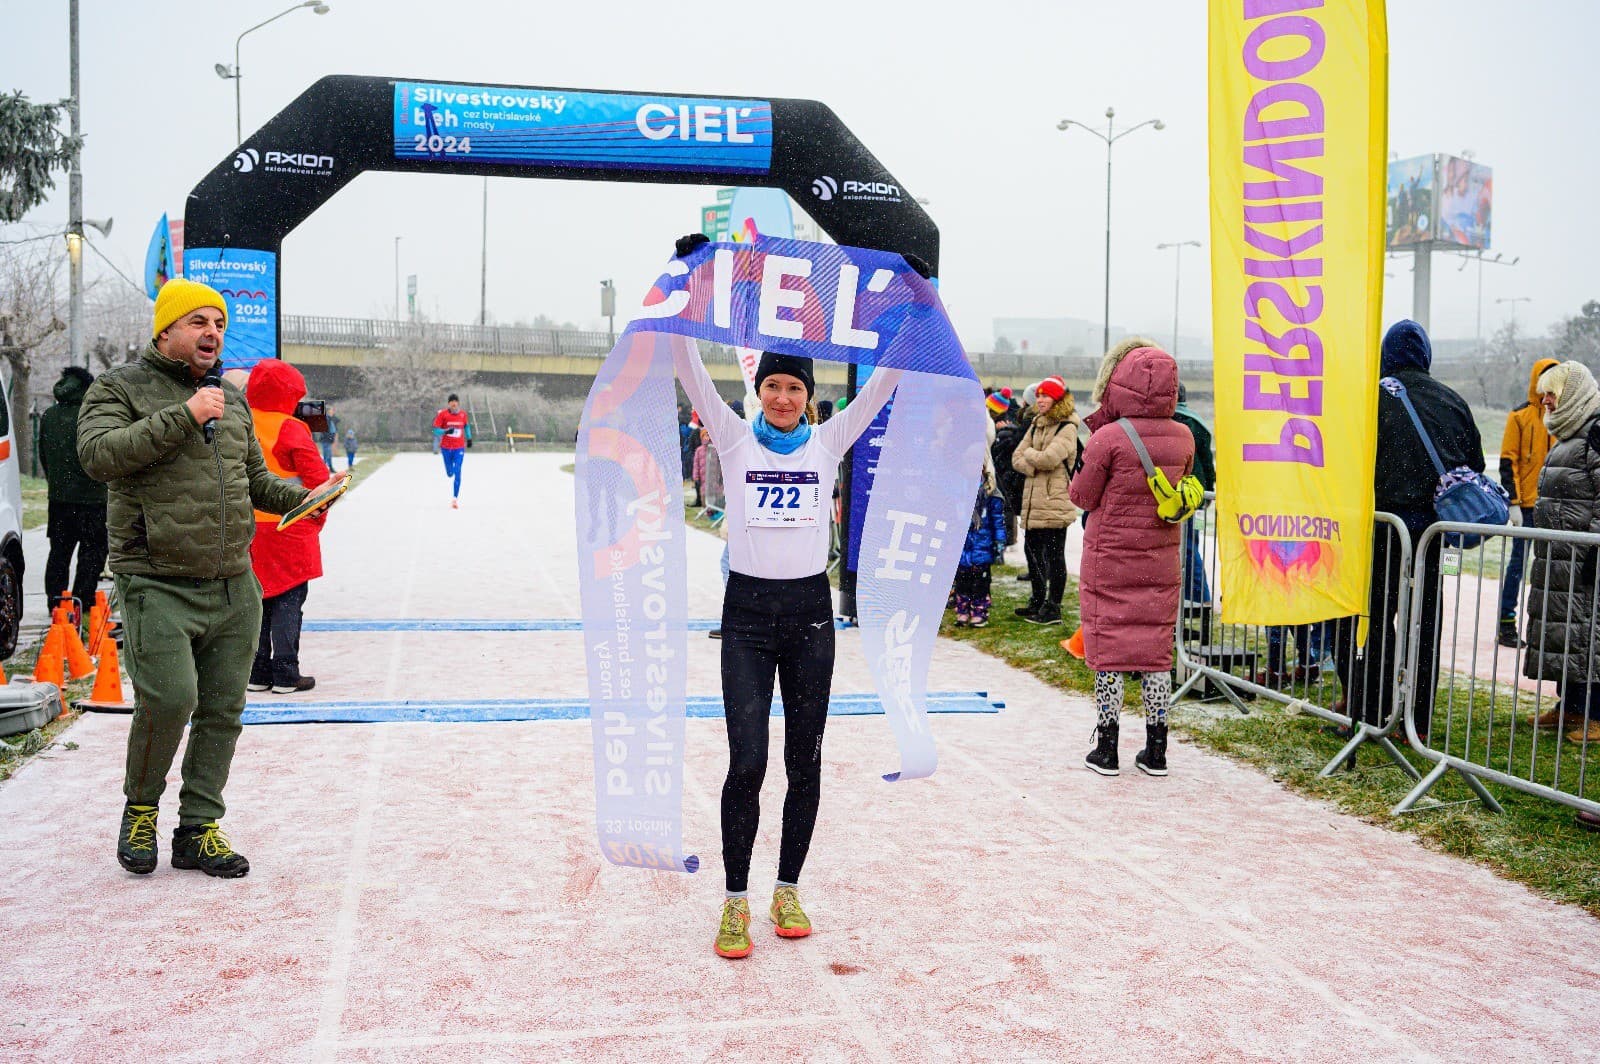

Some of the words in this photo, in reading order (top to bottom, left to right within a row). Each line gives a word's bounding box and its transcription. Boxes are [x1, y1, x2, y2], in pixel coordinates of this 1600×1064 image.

[413, 87, 567, 114] Silvestrovský
[413, 108, 459, 128] beh
[463, 111, 481, 119] cez
[482, 110, 542, 122] bratislavské
[636, 103, 754, 143] CIEĽ
[463, 121, 495, 132] mosty
[414, 134, 472, 154] 2024
[265, 151, 334, 169] AXION
[843, 180, 901, 197] AXION
[189, 259, 267, 275] Silvestrovský
[189, 273, 209, 283] beh
[627, 249, 894, 349] CIEĽ
[235, 303, 268, 316] 2024
[756, 486, 801, 509] 722
